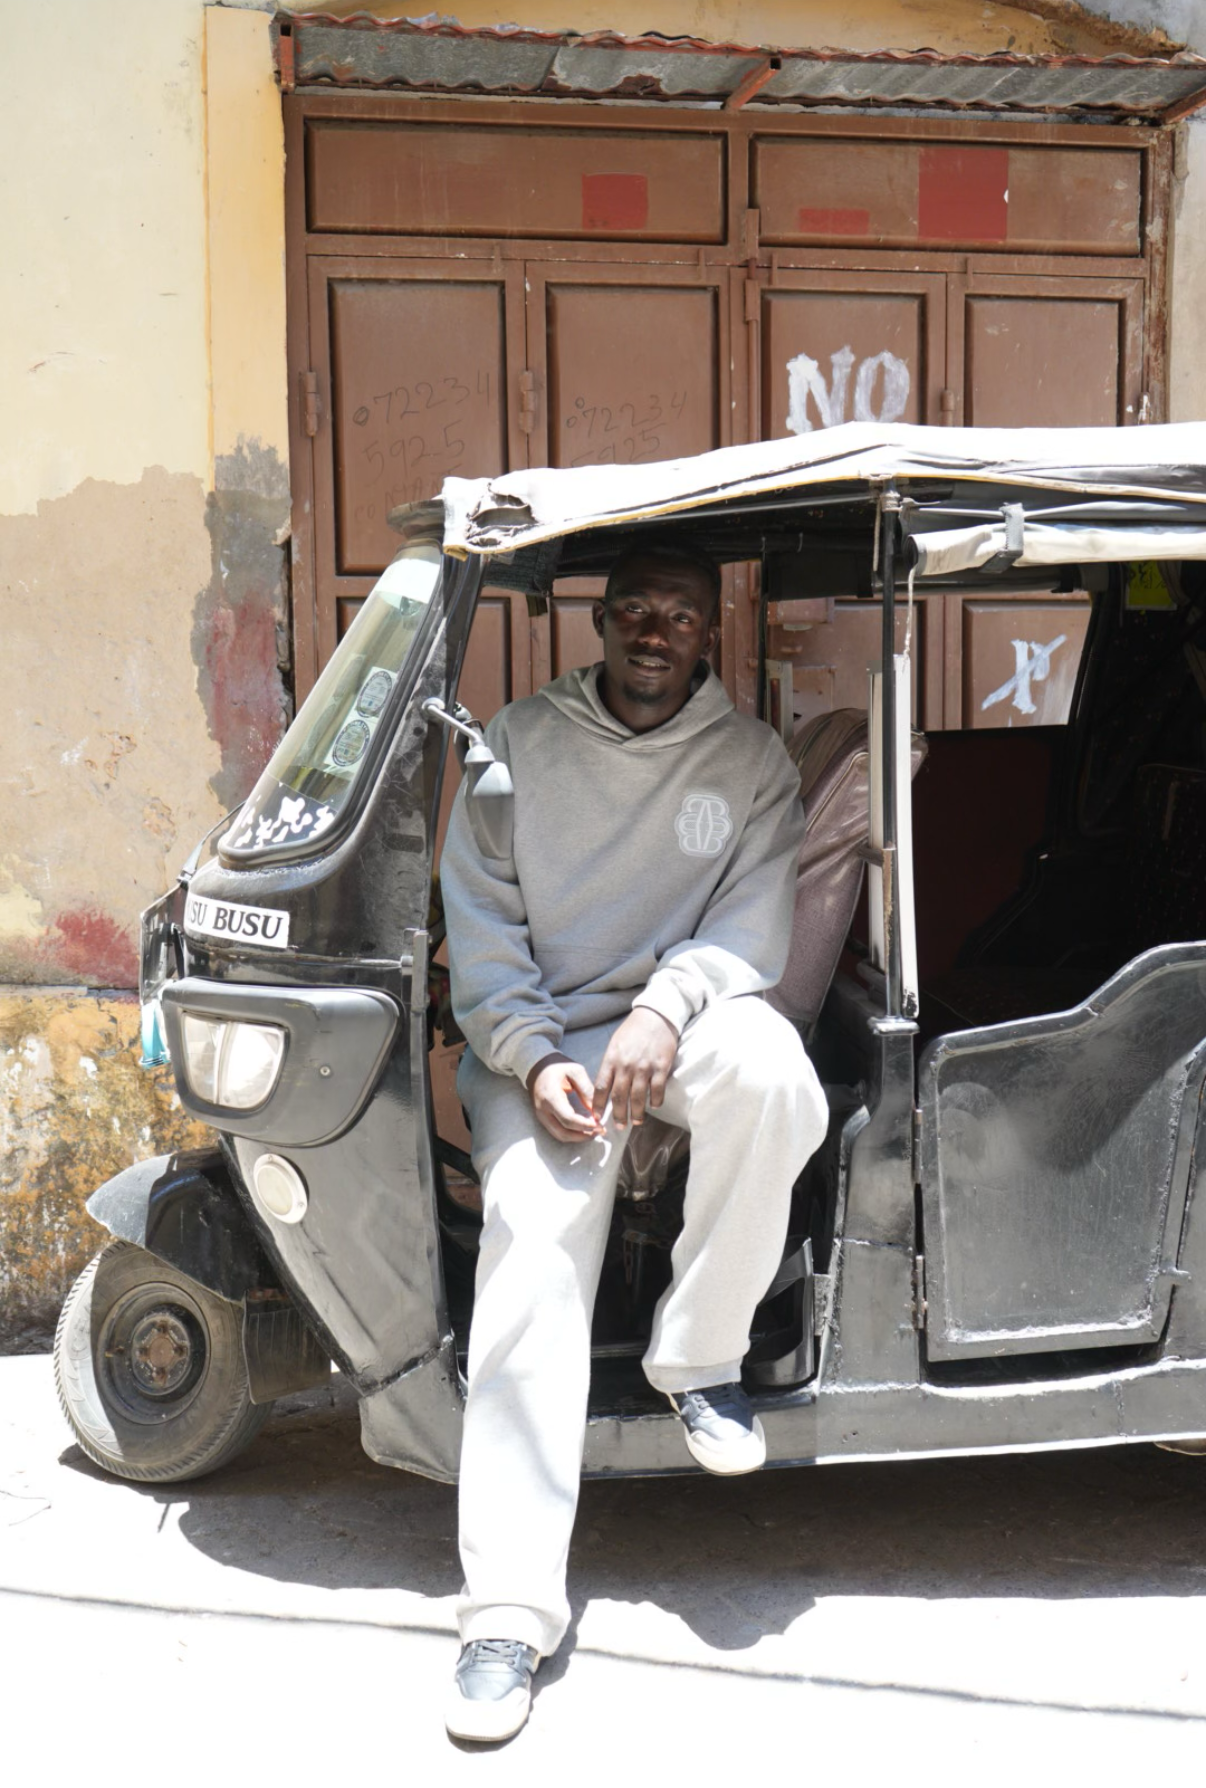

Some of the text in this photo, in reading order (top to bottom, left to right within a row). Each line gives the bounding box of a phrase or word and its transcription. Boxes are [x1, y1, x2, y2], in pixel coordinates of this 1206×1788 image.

[353, 369, 491, 428] 072234
[785, 345, 911, 435] NO
[188, 899, 284, 940] SU BUSU
